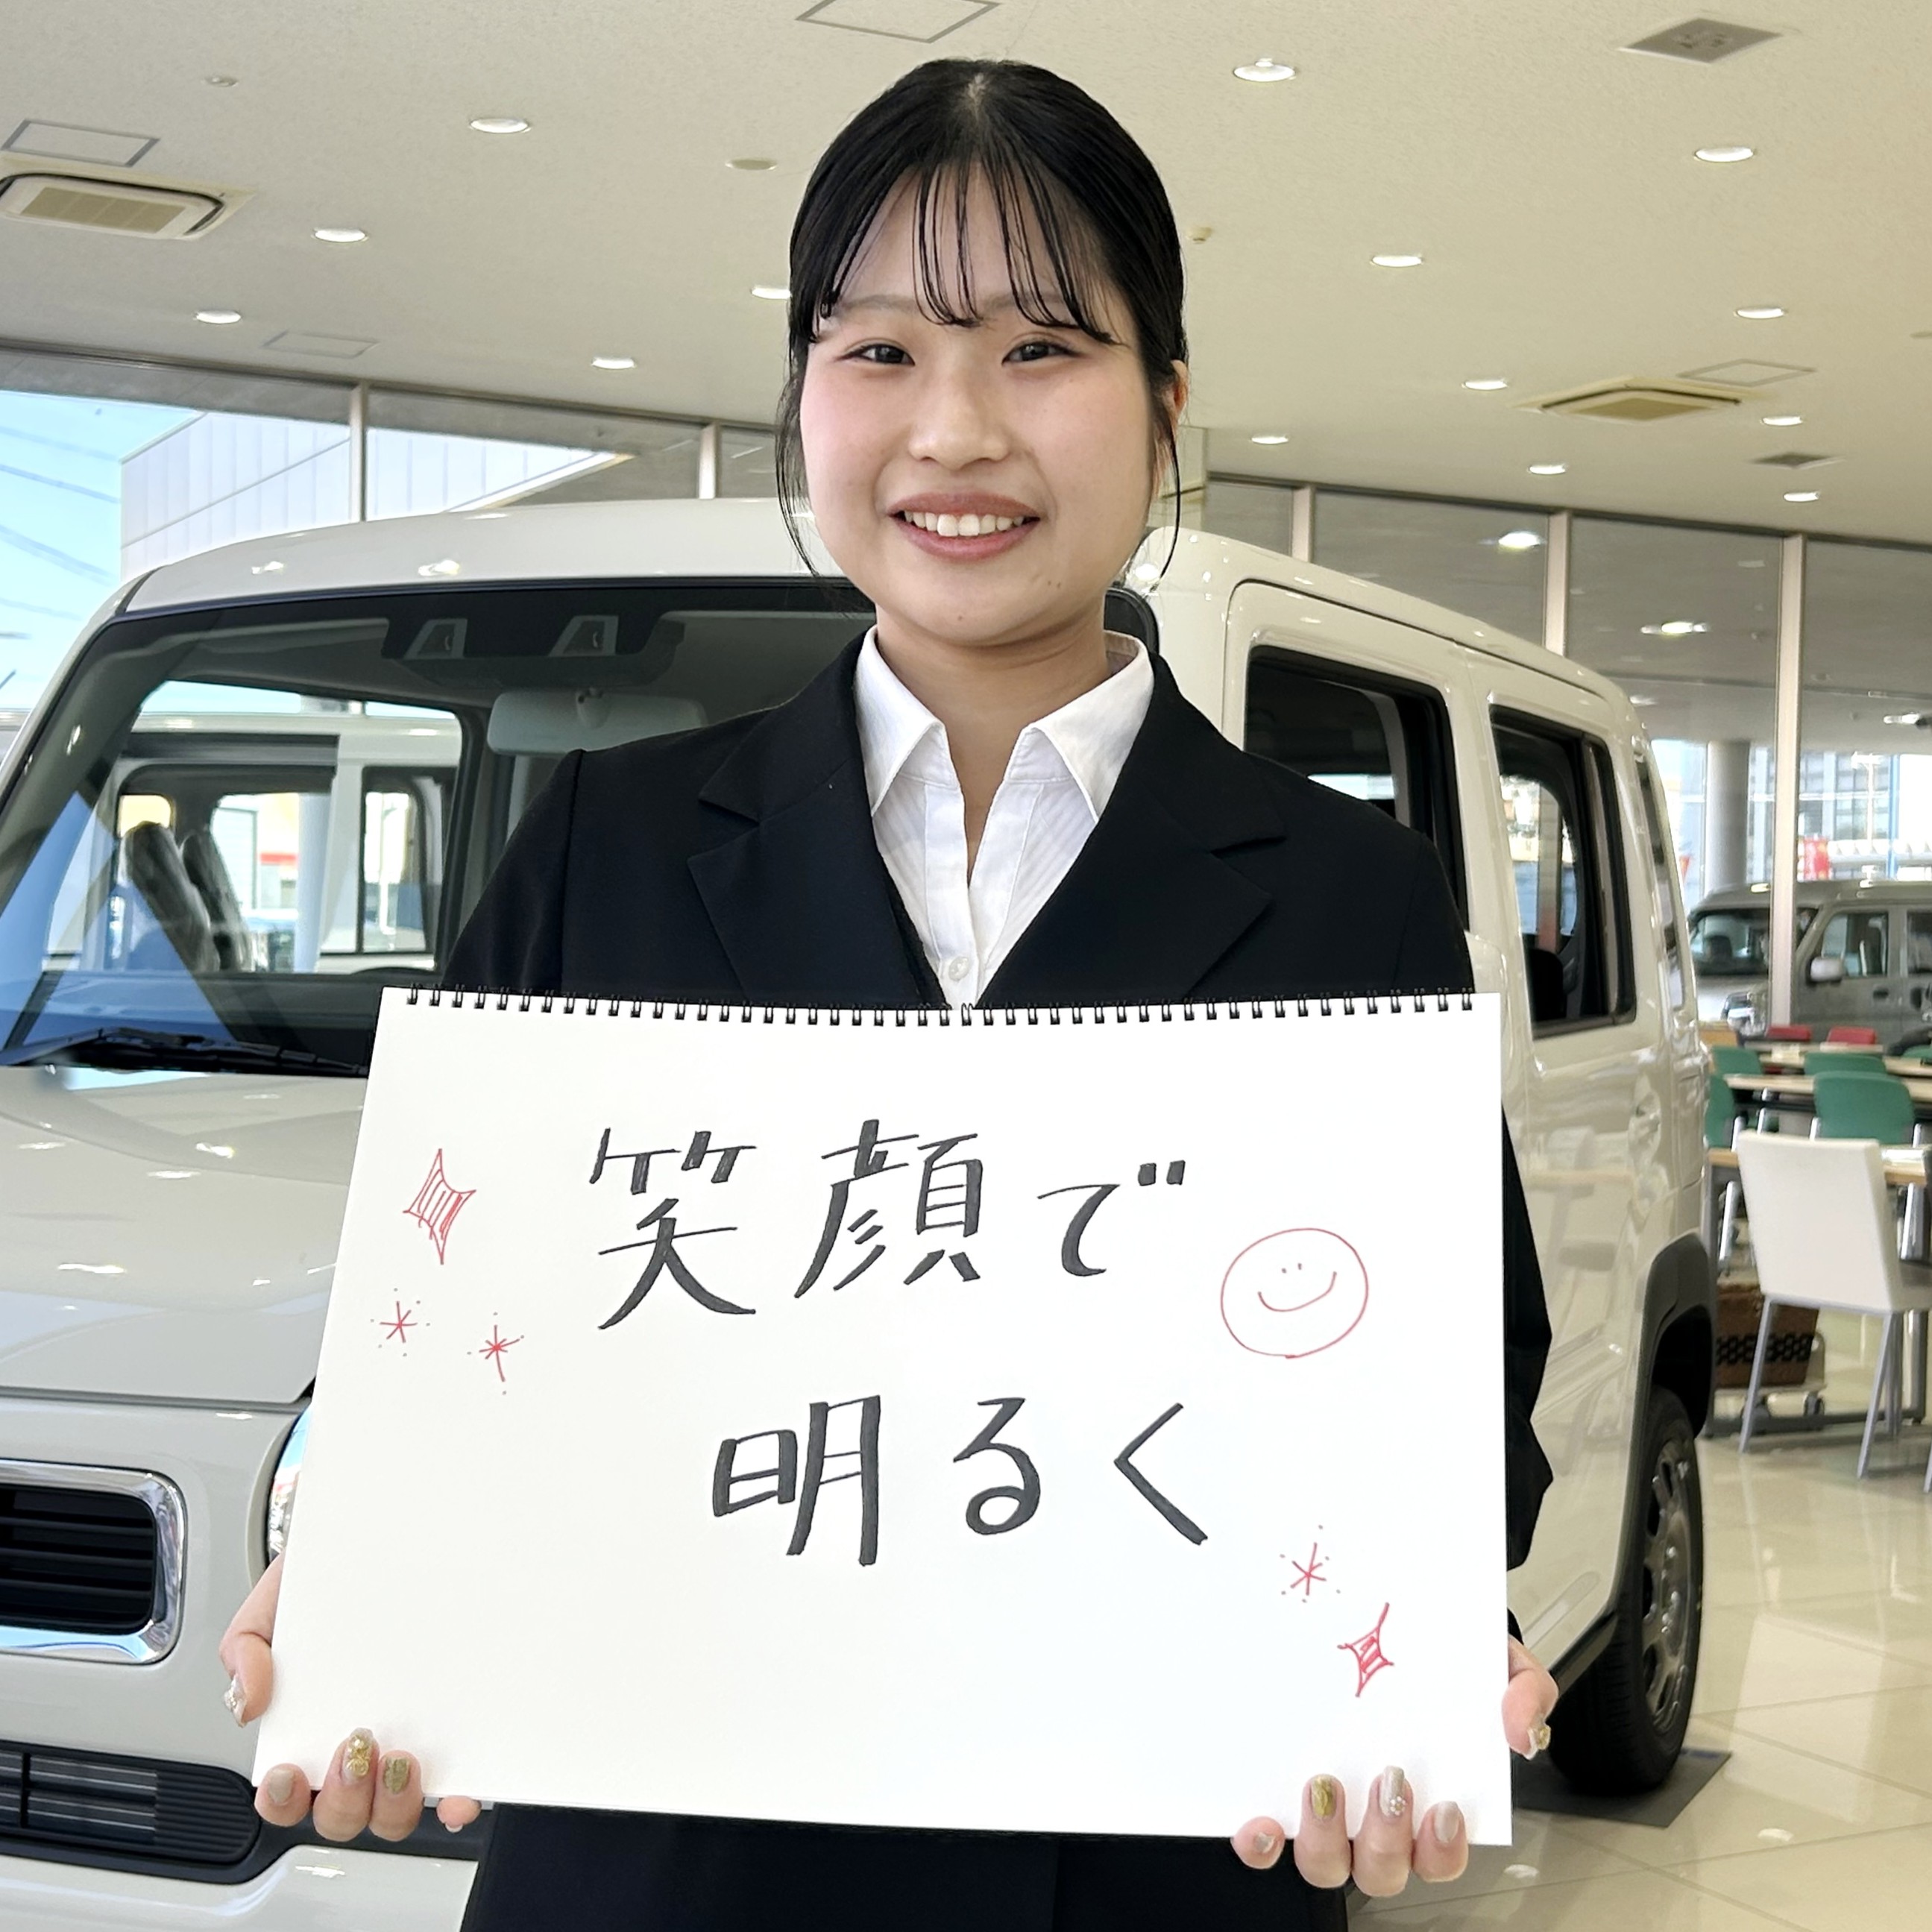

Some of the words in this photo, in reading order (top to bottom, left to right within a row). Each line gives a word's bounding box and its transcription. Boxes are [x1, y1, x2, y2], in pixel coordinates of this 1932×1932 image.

[589, 1119, 1186, 1330] 笑顔で
[712, 1394, 1208, 1567] 明るく
